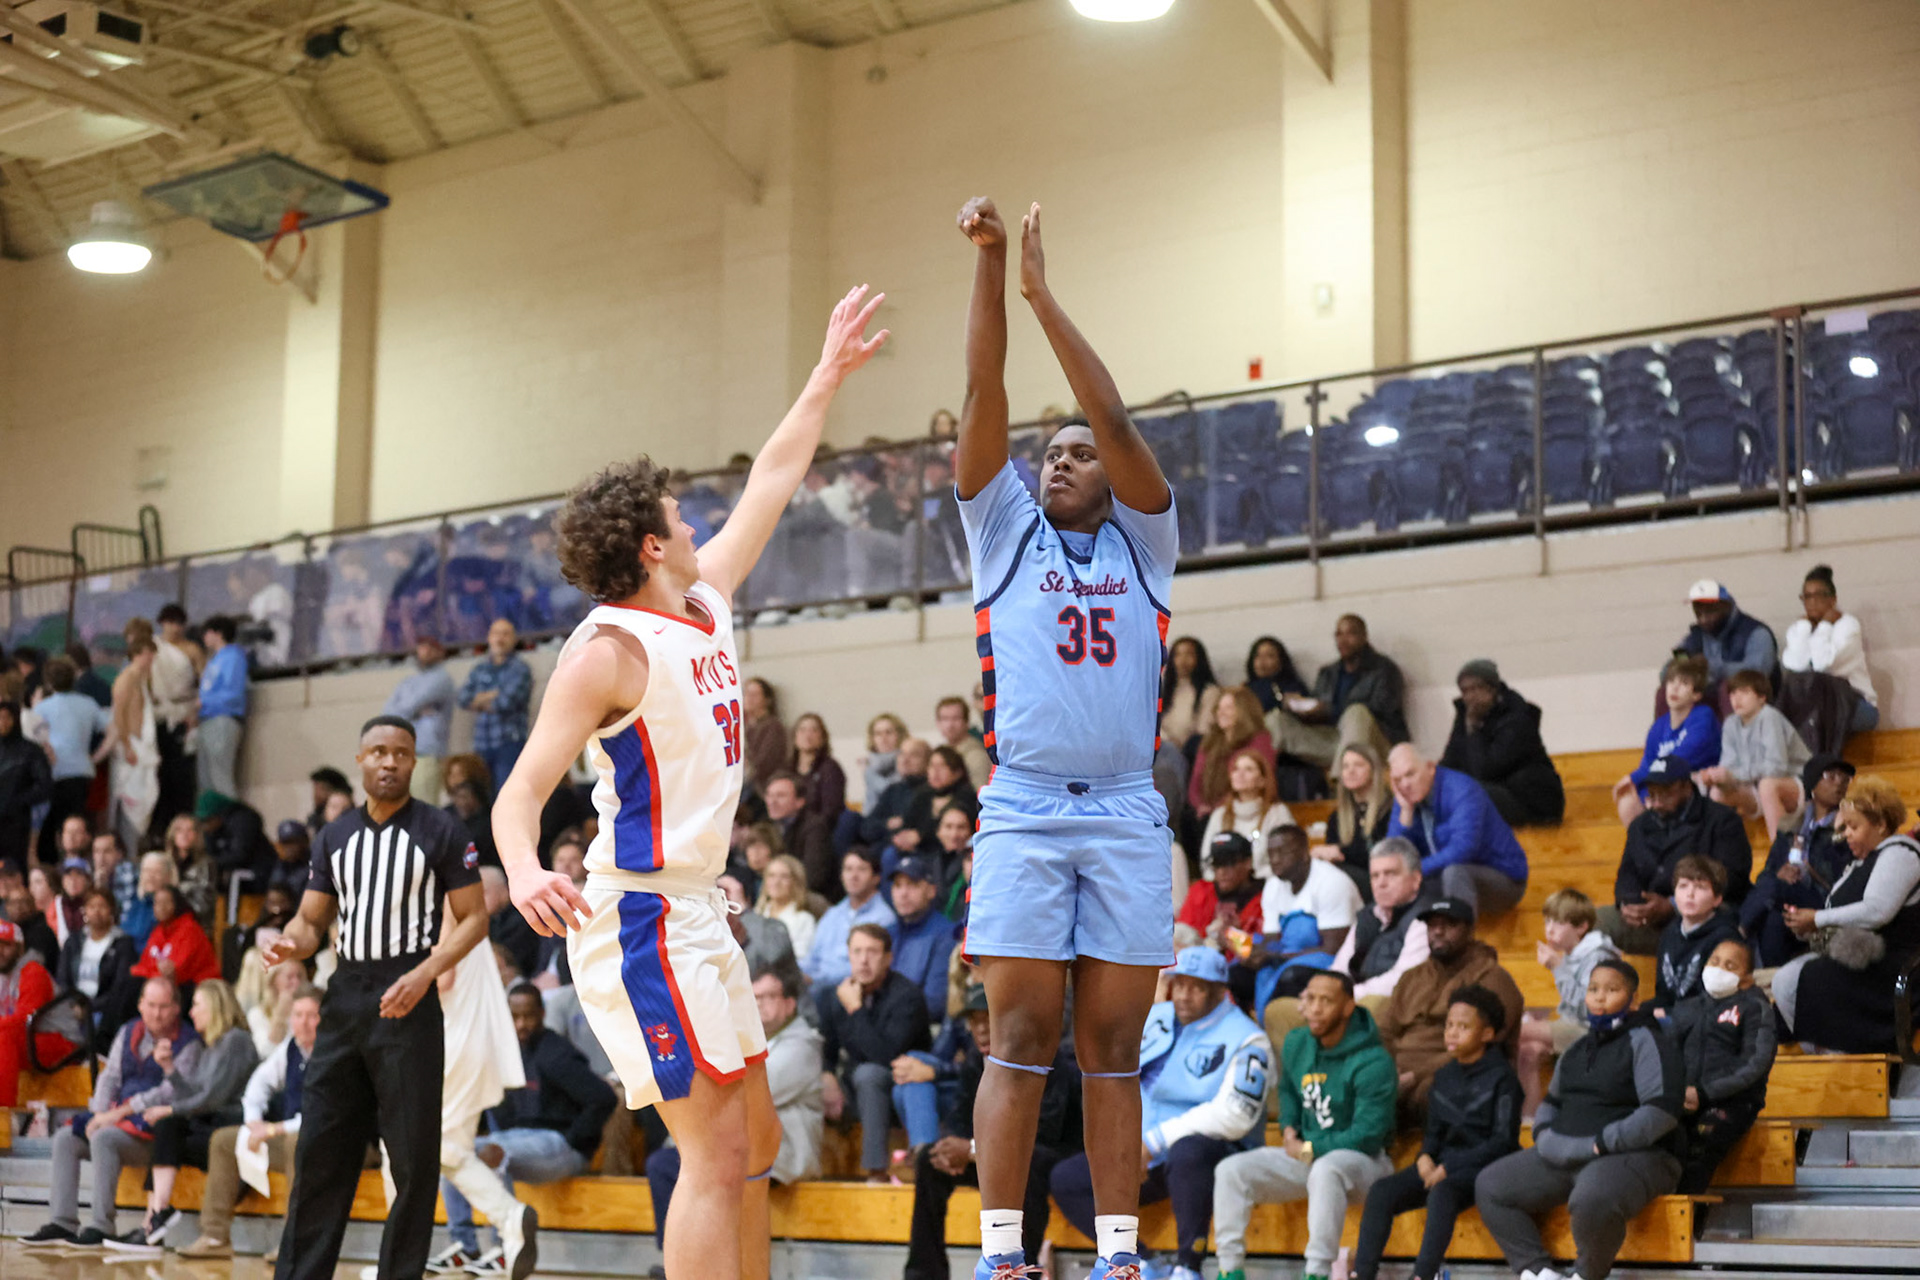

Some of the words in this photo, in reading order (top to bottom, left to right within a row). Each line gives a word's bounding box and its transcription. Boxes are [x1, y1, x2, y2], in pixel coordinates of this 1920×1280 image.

[1040, 570, 1065, 592] St
[1056, 605, 1118, 667] 35
[690, 650, 737, 696] MUS
